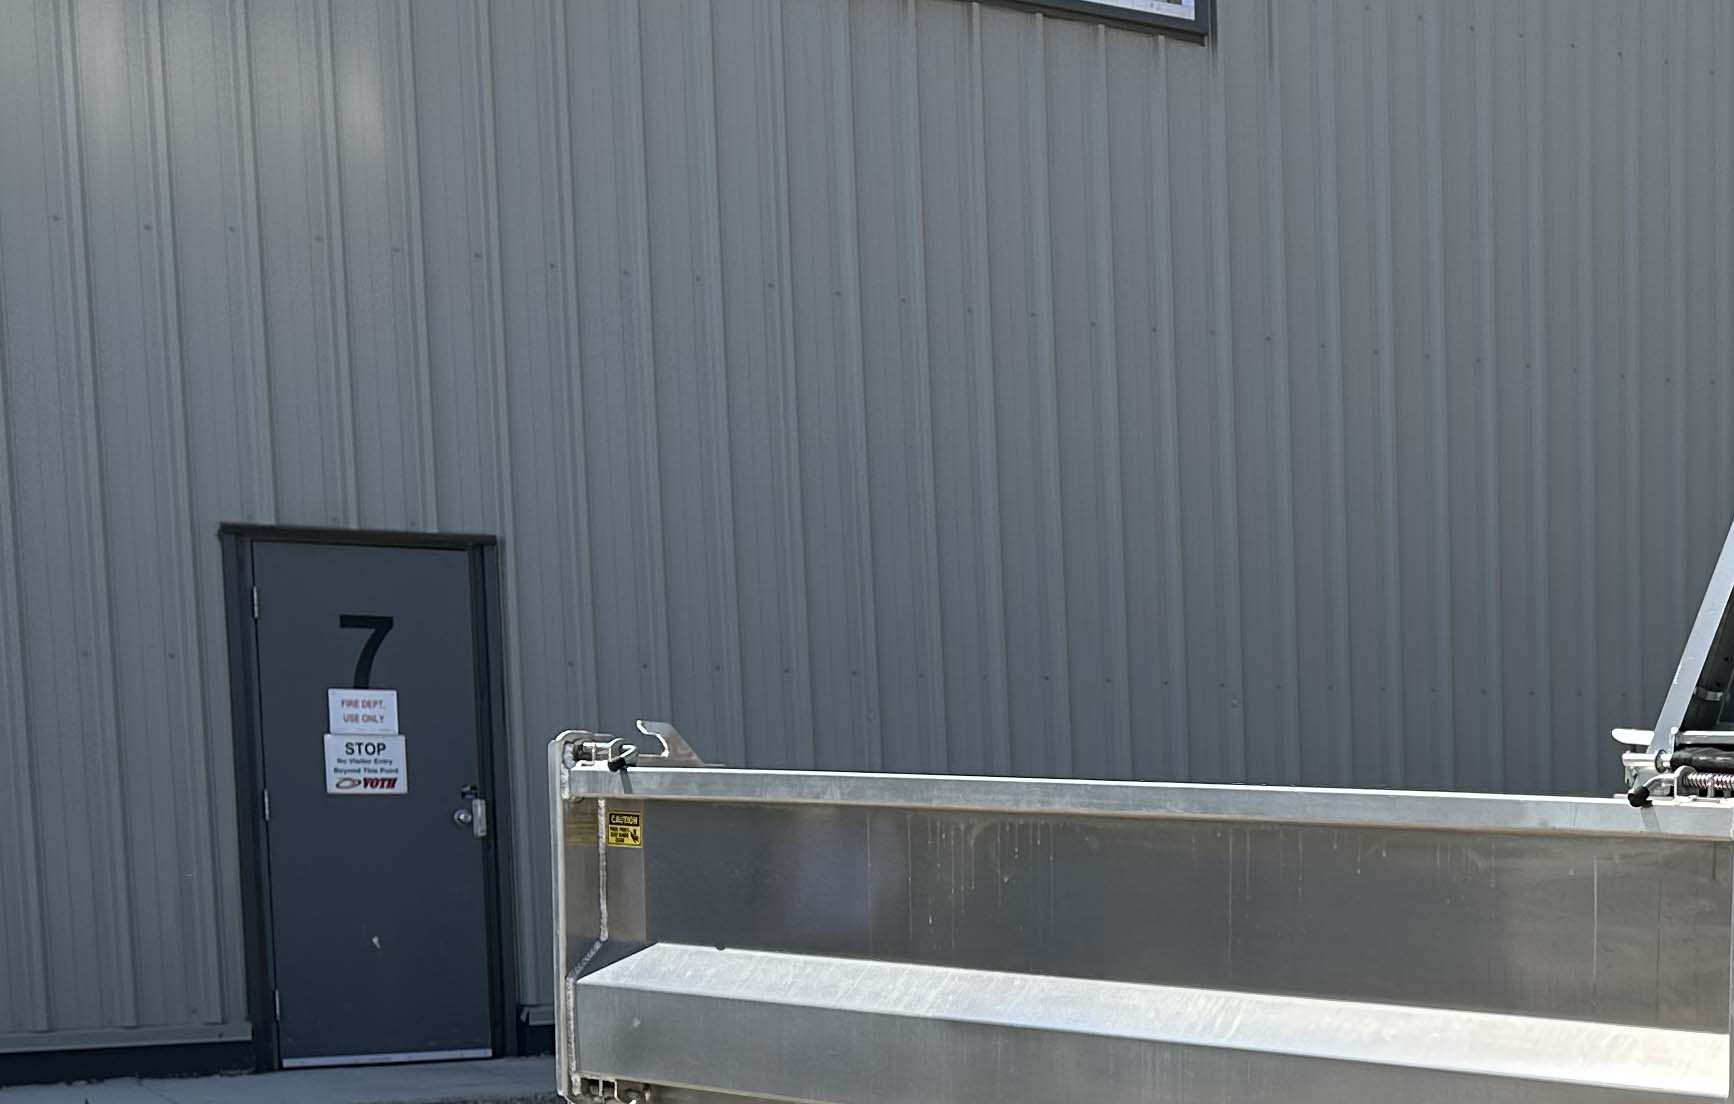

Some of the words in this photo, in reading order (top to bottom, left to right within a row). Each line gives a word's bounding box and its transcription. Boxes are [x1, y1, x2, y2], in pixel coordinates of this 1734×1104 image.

[339, 614, 394, 689] 7
[341, 699, 359, 709] FIRE
[343, 713, 359, 723] USE
[361, 713, 384, 723] ONLY
[345, 741, 386, 756] STOP
[374, 757, 393, 767] Entry
[362, 777, 398, 790] VOTH
